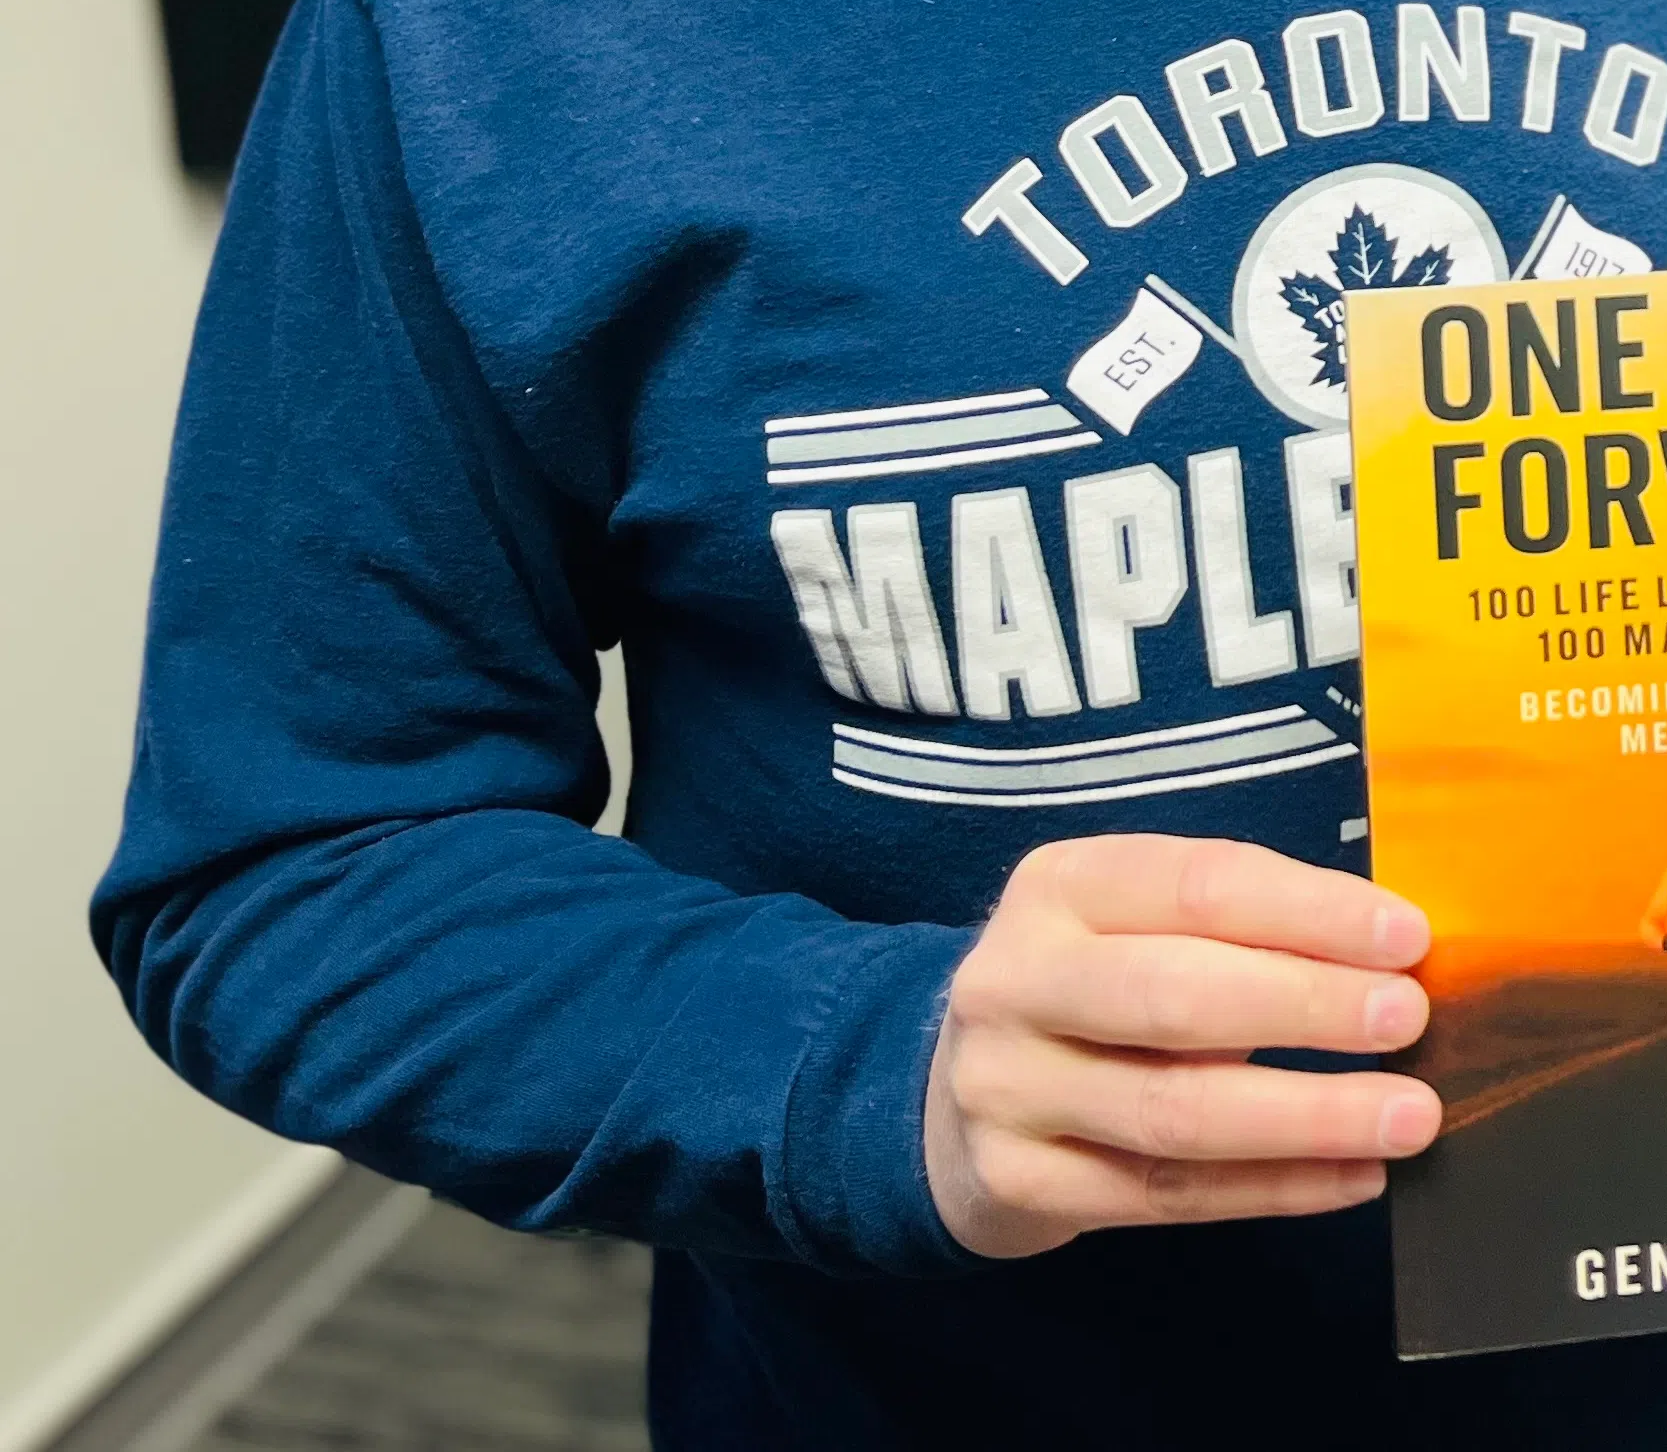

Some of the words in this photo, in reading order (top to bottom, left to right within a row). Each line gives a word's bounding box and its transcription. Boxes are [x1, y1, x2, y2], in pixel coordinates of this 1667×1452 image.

[1103, 331, 1175, 391] EST.
[1420, 294, 1655, 422] ONE
[1469, 585, 1535, 621] 100
[1554, 578, 1639, 615] LIFE
[1538, 627, 1605, 662] 100
